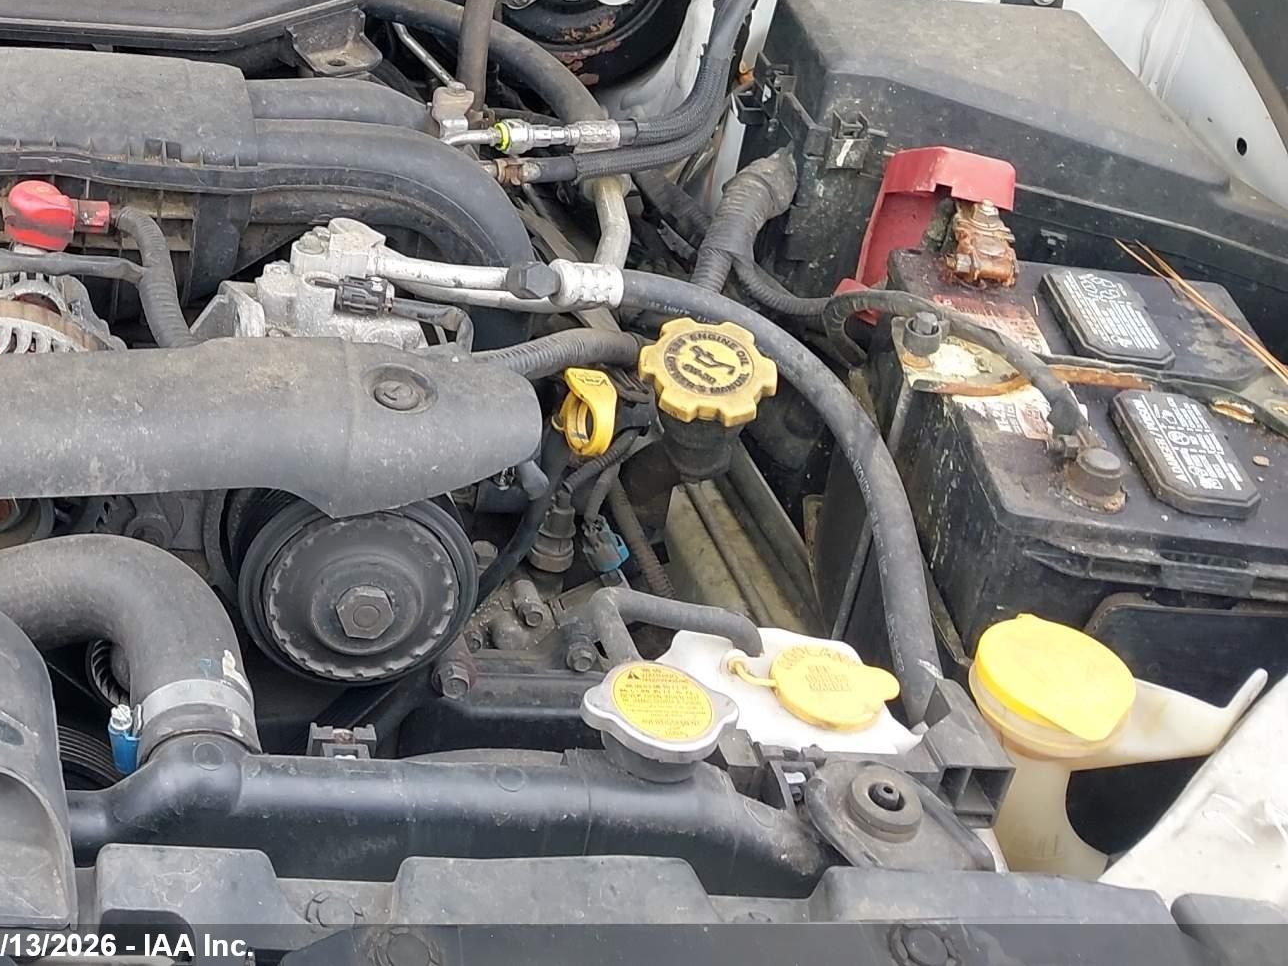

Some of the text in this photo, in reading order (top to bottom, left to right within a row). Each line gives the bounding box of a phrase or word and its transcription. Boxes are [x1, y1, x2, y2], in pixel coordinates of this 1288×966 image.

[689, 333, 738, 351] ENGINE
[736, 350, 750, 367] OIL
[710, 373, 750, 394] MANUAL
[1132, 398, 1159, 432] POISON
[1155, 437, 1184, 474] DANGER
